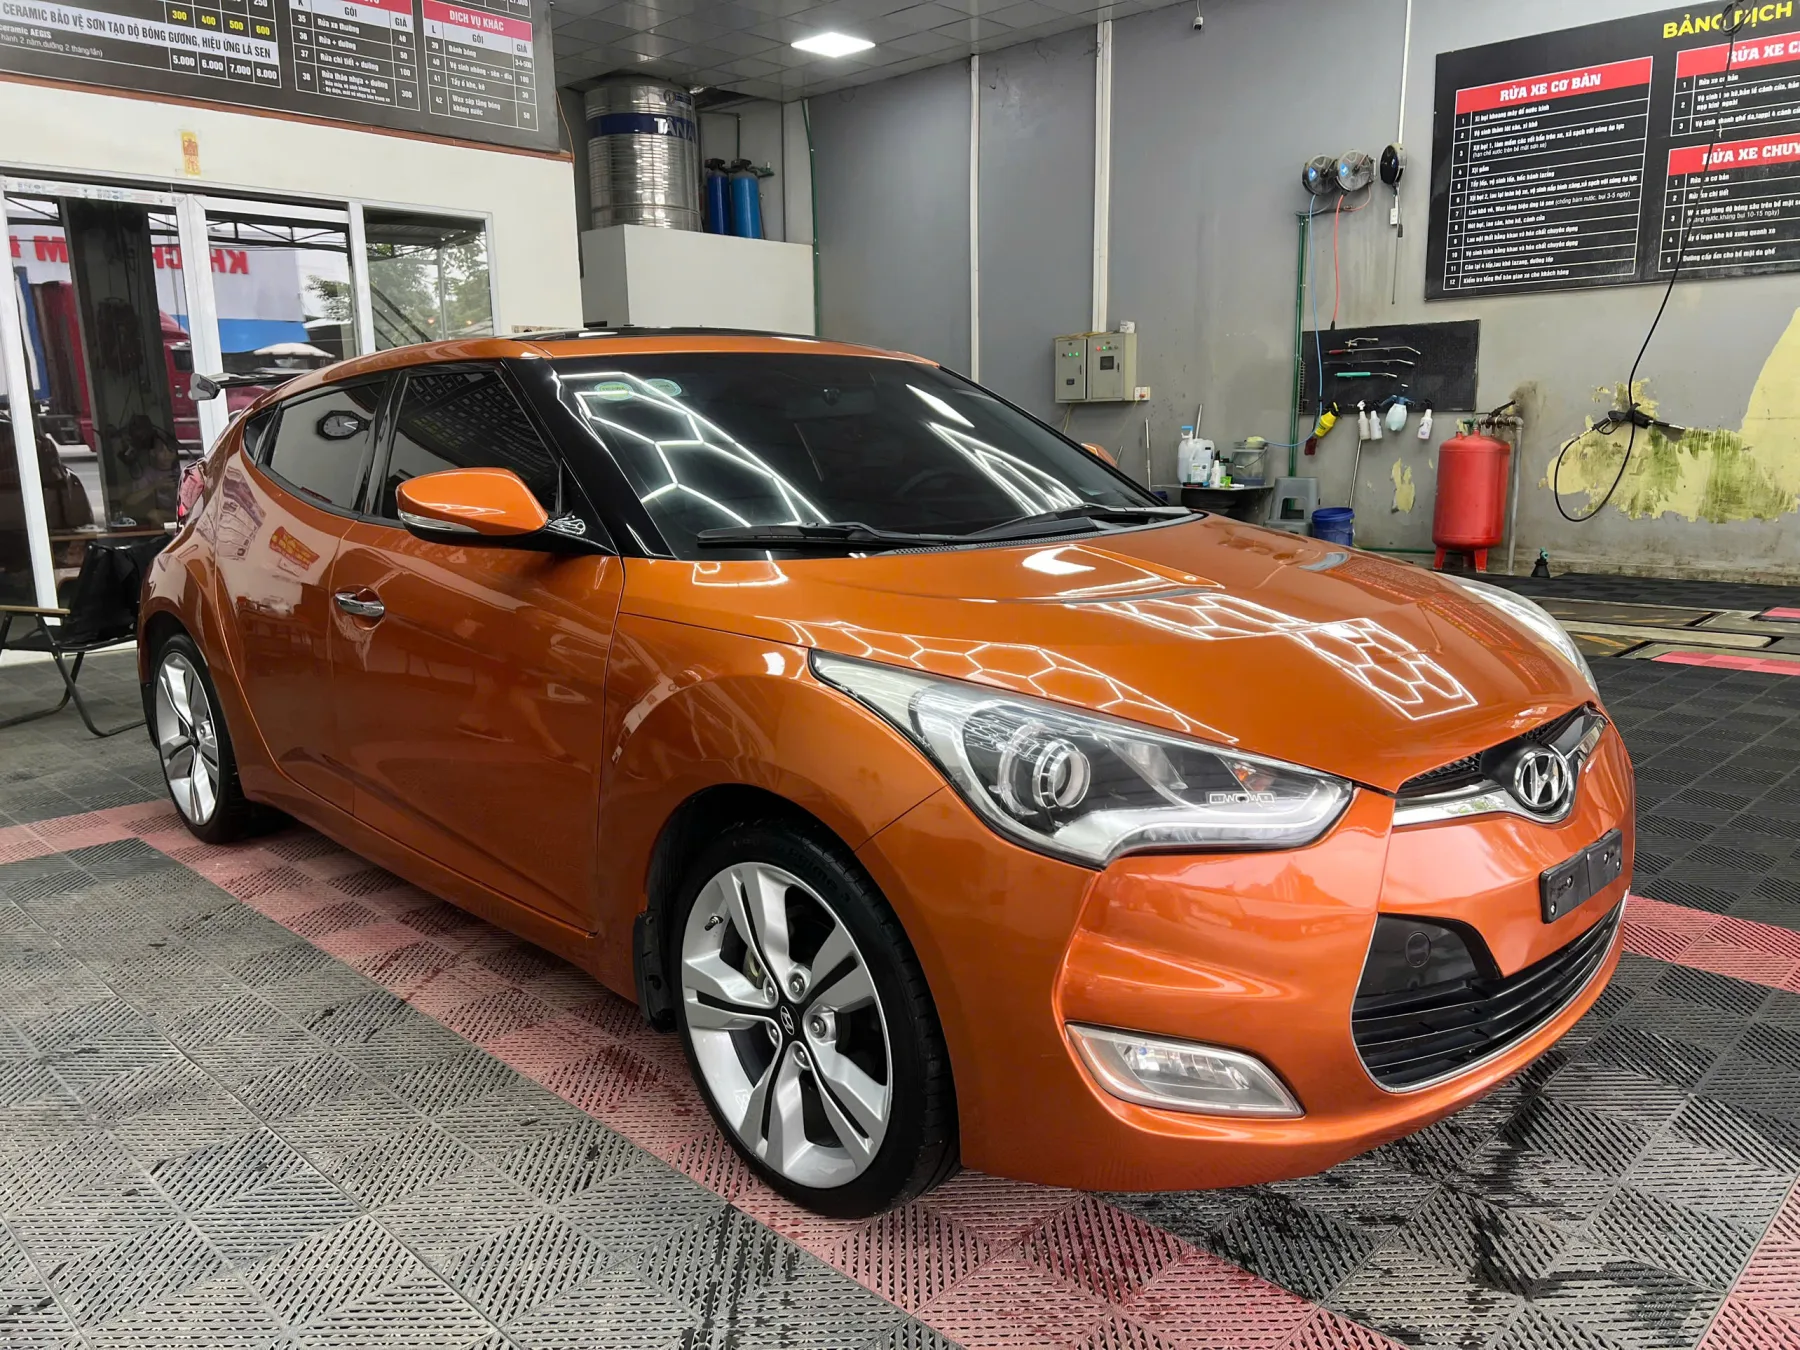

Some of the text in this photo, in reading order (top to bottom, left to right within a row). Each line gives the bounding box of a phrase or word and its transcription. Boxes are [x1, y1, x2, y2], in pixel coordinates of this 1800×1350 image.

[344, 7, 357, 17] GÓI
[172, 10, 270, 35] 300 400 500 600
[298, 15, 306, 23] 35
[395, 17, 407, 27] GIÁ
[450, 10, 504, 31] DỊCH VỤ KHÁC
[1663, 2, 1792, 38] BẢNG DỊCH
[3, 3, 48, 21] CERAMIC
[50, 9, 70, 25] BẢO
[72, 14, 84, 30] VỆ
[87, 18, 106, 31] SƠN
[108, 21, 125, 35] TẠO
[142, 27, 166, 41] BÓNG
[168, 32, 200, 47] GƯƠNG,
[202, 37, 221, 51] HIỆU
[223, 40, 240, 53] ỨNG
[242, 43, 252, 55] LÁ
[255, 46, 271, 58] SEN
[30, 29, 52, 38] AEGIS
[432, 25, 436, 33] L
[472, 34, 484, 44] GÓI
[517, 44, 528, 53] GIÁ
[1727, 47, 1759, 62] RỬA
[1763, 43, 1784, 57] XE
[173, 55, 277, 79] 5.000 6.000 7.000 8.000
[1500, 73, 1601, 101] RỬA XE CƠ BẢN
[402, 90, 412, 98] 300
[435, 96, 443, 104] 42
[1702, 149, 1734, 165] RỬA
[1738, 147, 1758, 160] XE
